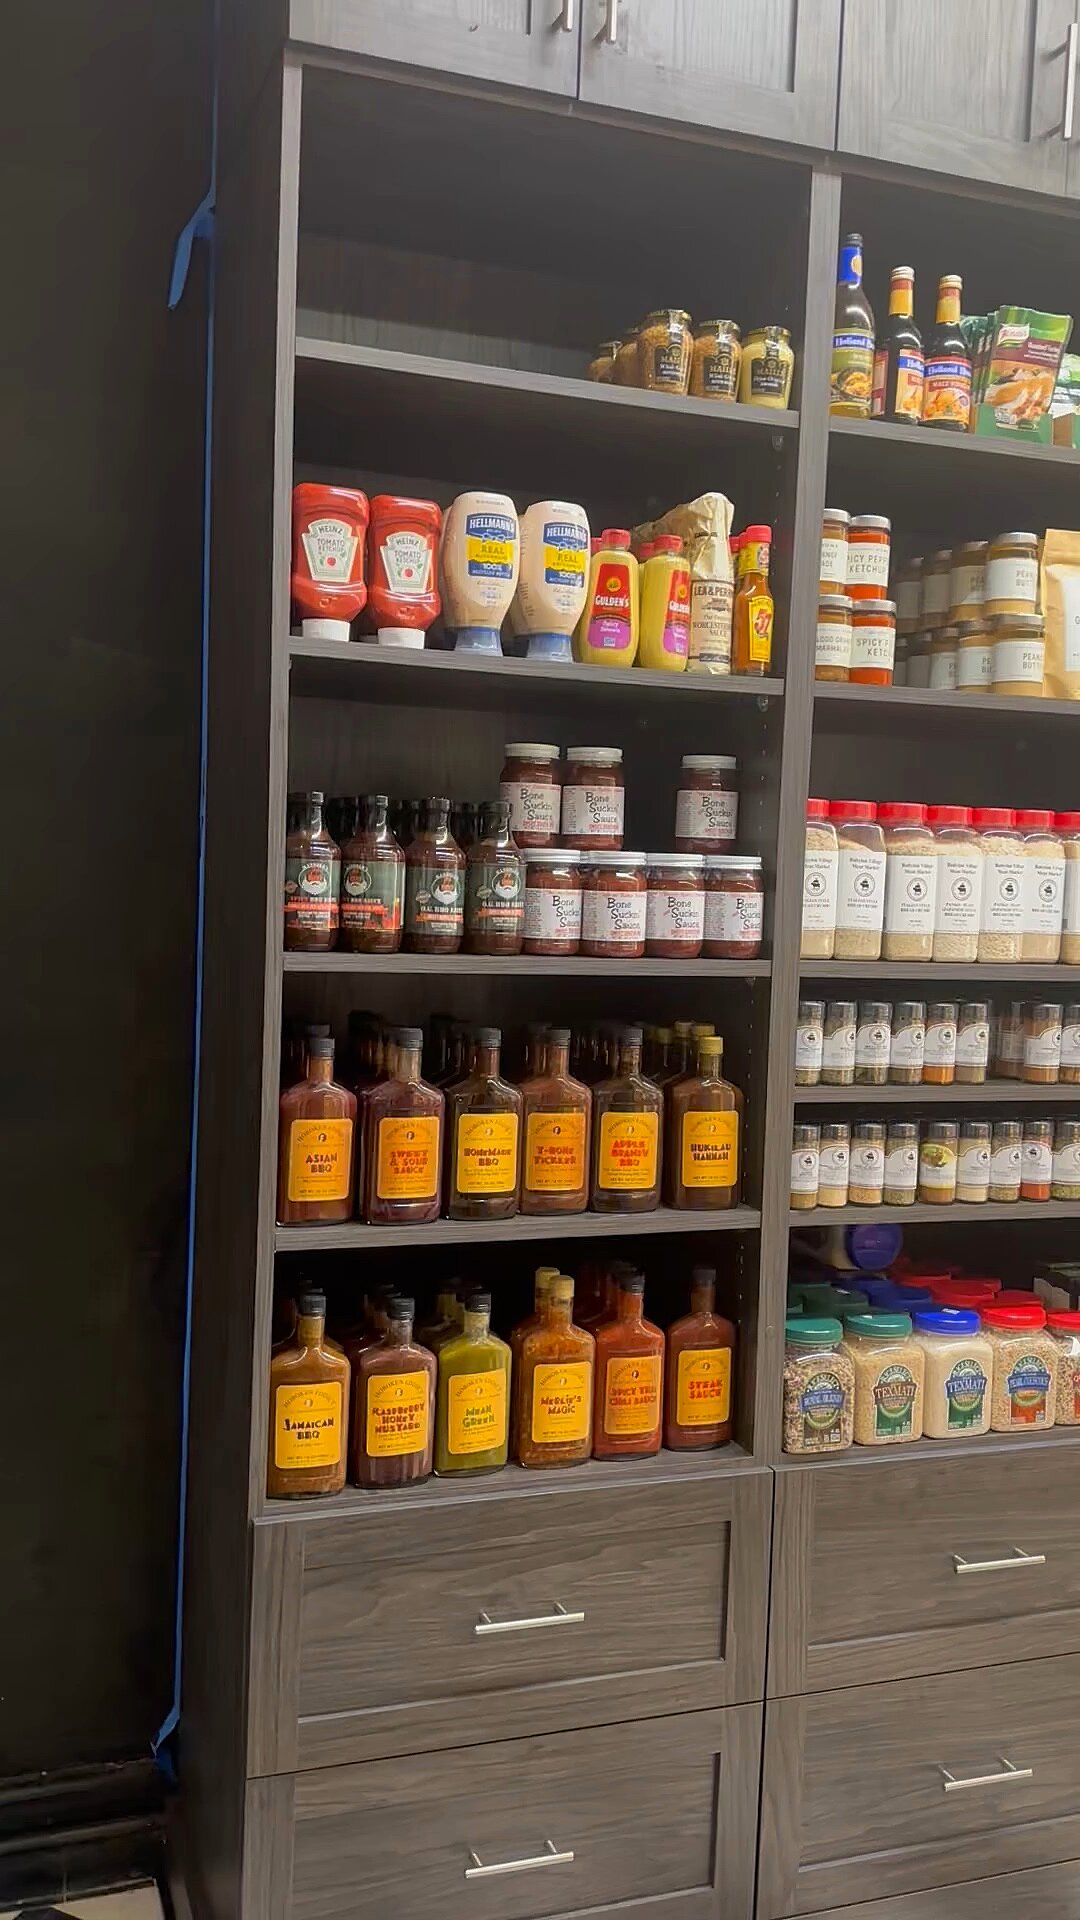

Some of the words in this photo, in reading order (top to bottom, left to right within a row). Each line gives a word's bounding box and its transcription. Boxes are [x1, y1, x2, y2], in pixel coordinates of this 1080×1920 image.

[318, 525, 343, 534] HEINZ
[317, 538, 345, 548] TOMATO
[396, 537, 418, 546] HEINZ
[394, 550, 421, 559] TOMATO
[481, 545, 505, 554] REAL
[594, 594, 630, 608] GULDEN'S
[856, 638, 882, 647] SPICY
[520, 788, 544, 800] Bone
[586, 792, 610, 803] Bone
[702, 796, 725, 807] Bone
[593, 812, 617, 824] Sauce
[552, 895, 574, 906] Bone
[607, 897, 632, 908] Bone
[668, 896, 691, 908] Bone
[736, 898, 758, 909] Bone
[615, 919, 640, 930] Sauce
[613, 1140, 645, 1148] APPLE
[390, 1150, 429, 1158] SWEET
[536, 1145, 575, 1155] T-BONE
[611, 1148, 649, 1158] BRANDY
[306, 1152, 337, 1164] ASIAN
[403, 1157, 428, 1167] SOUR
[478, 1157, 499, 1166] BBQ
[619, 1158, 640, 1167] BBQ
[311, 1164, 332, 1174] BBQ
[393, 1166, 424, 1175] SAUCE
[688, 1379, 723, 1389] STEAK
[948, 1379, 985, 1392] TEXMATI
[689, 1389, 722, 1399] SAUCE
[876, 1384, 915, 1399] TEXMATI
[372, 1403, 425, 1417] RASPBERRY
[466, 1405, 493, 1416] MEAN
[548, 1404, 576, 1414] MAGIC
[282, 1417, 334, 1431] JAMAICAN
[382, 1414, 415, 1424] HONEY
[462, 1414, 495, 1427] GREEN
[375, 1423, 420, 1434] MUSTARD
[296, 1431, 320, 1440] BBQ
